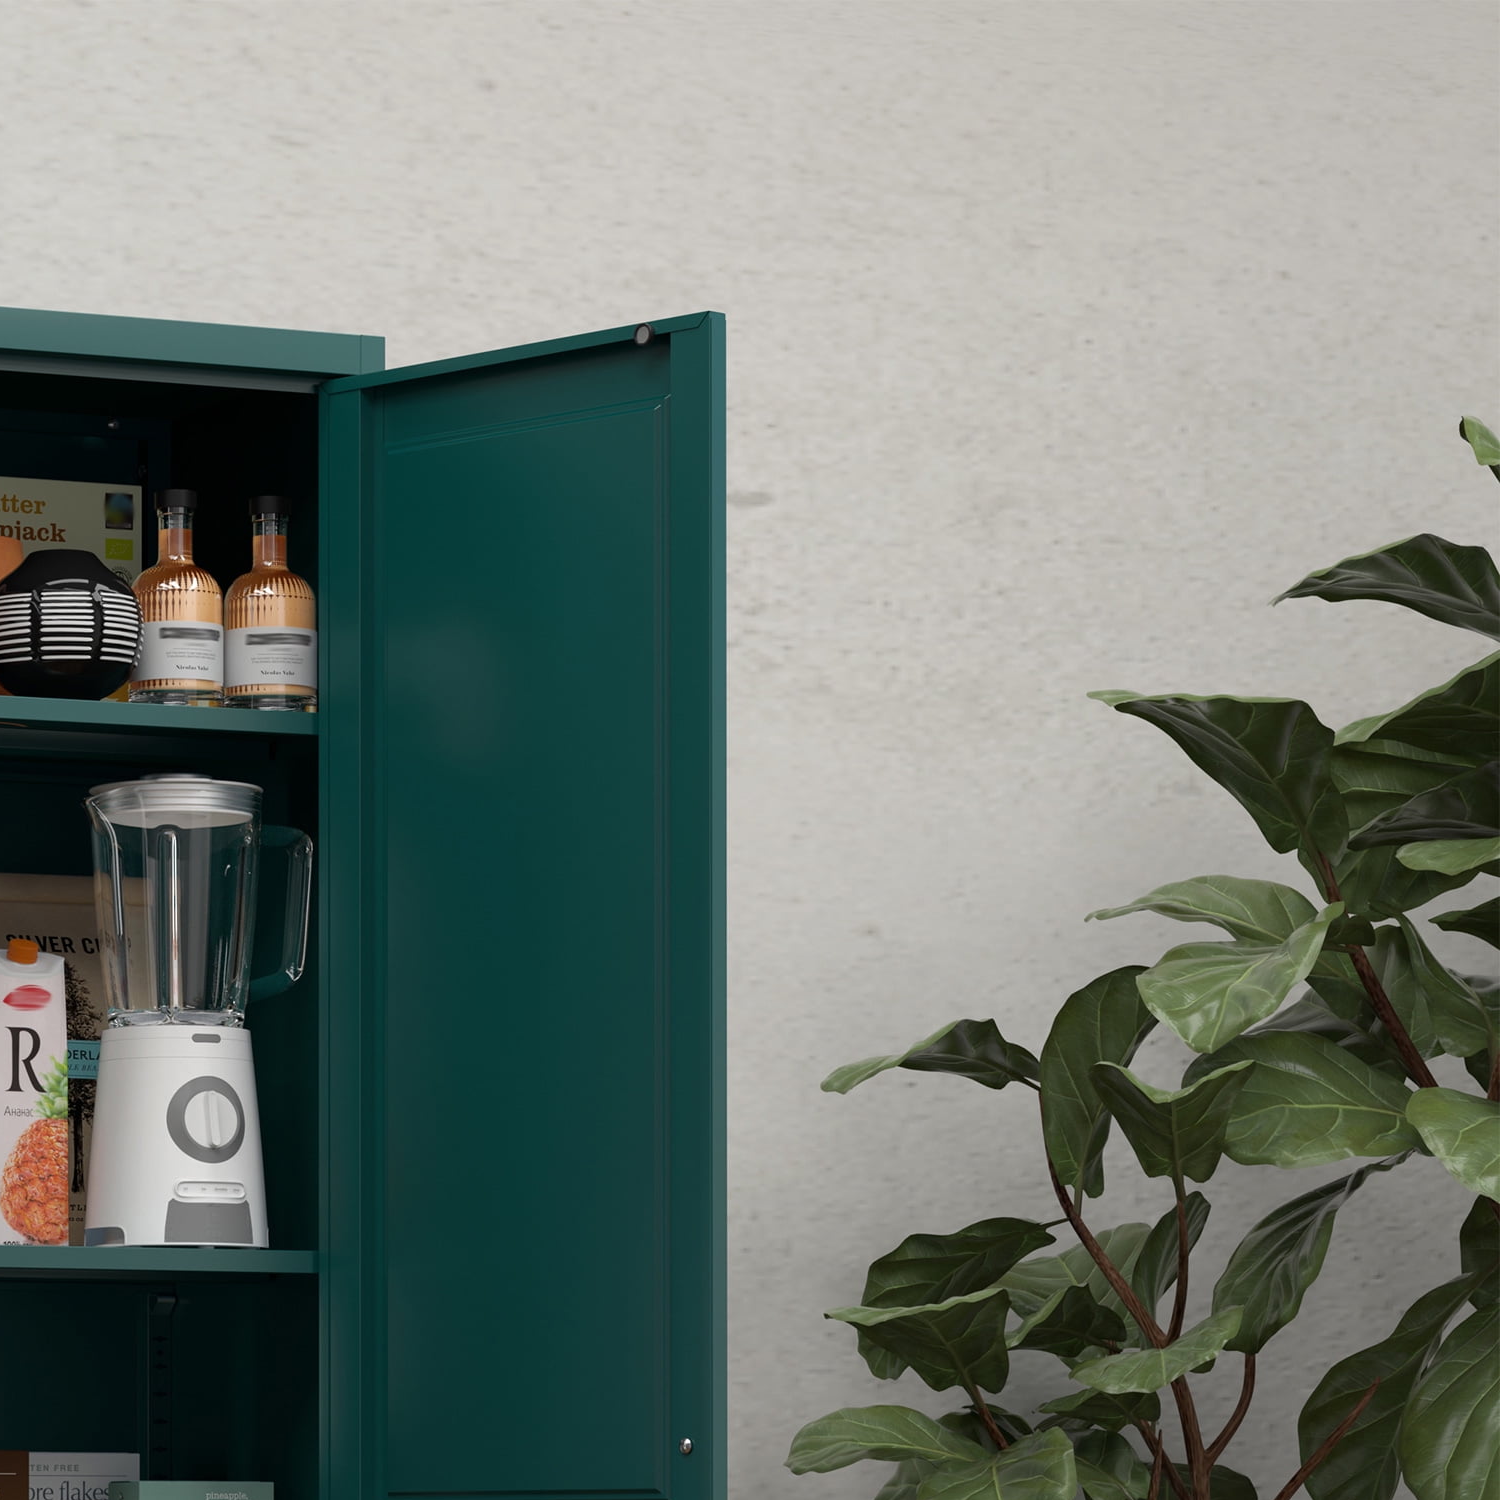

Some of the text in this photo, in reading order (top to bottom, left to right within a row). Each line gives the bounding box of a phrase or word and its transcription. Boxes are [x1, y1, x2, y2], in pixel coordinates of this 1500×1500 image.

[4, 1026, 47, 1093] R
[30, 1464, 80, 1472] TEN FREE
